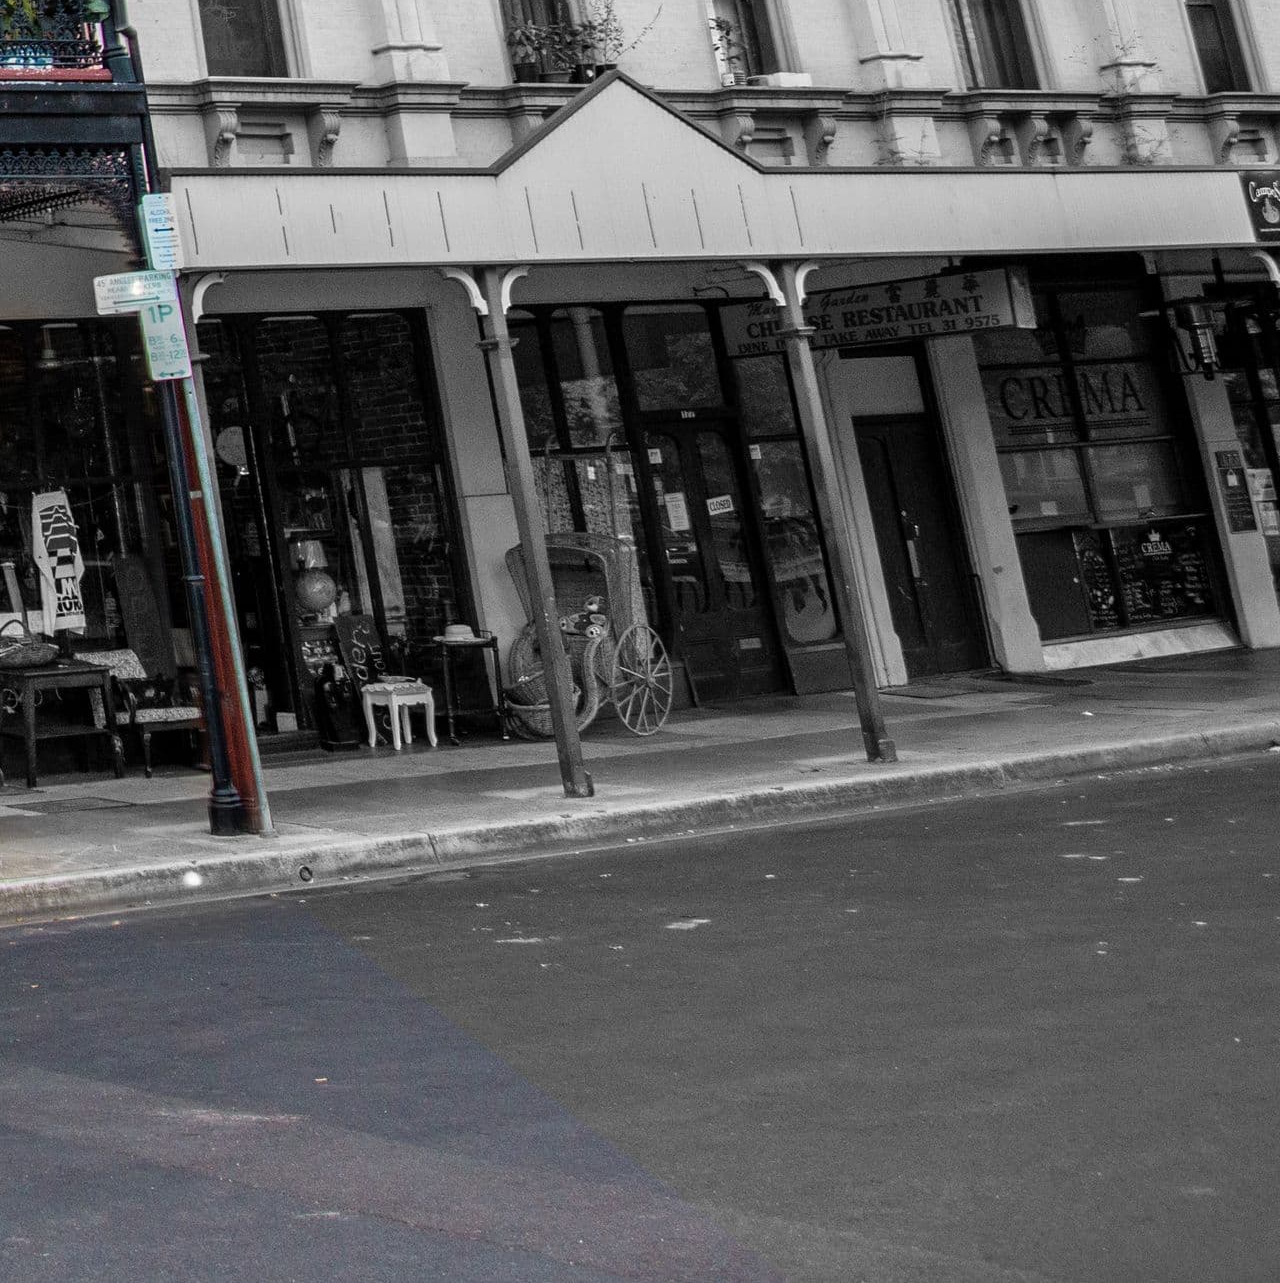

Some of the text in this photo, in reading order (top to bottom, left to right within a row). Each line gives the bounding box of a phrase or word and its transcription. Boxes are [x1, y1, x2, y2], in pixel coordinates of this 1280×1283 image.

[148, 304, 174, 324] 1P
[746, 315, 834, 339] CHISE
[842, 295, 983, 329] RESTAURANT
[738, 342, 769, 354] DINE
[824, 330, 859, 344] TAKE
[865, 325, 900, 340] AWAY
[909, 322, 935, 335] TEL
[941, 319, 957, 331] 31
[964, 315, 1001, 329] 9575
[709, 498, 731, 512] CLOSED
[1141, 541, 1172, 553] CREMA
